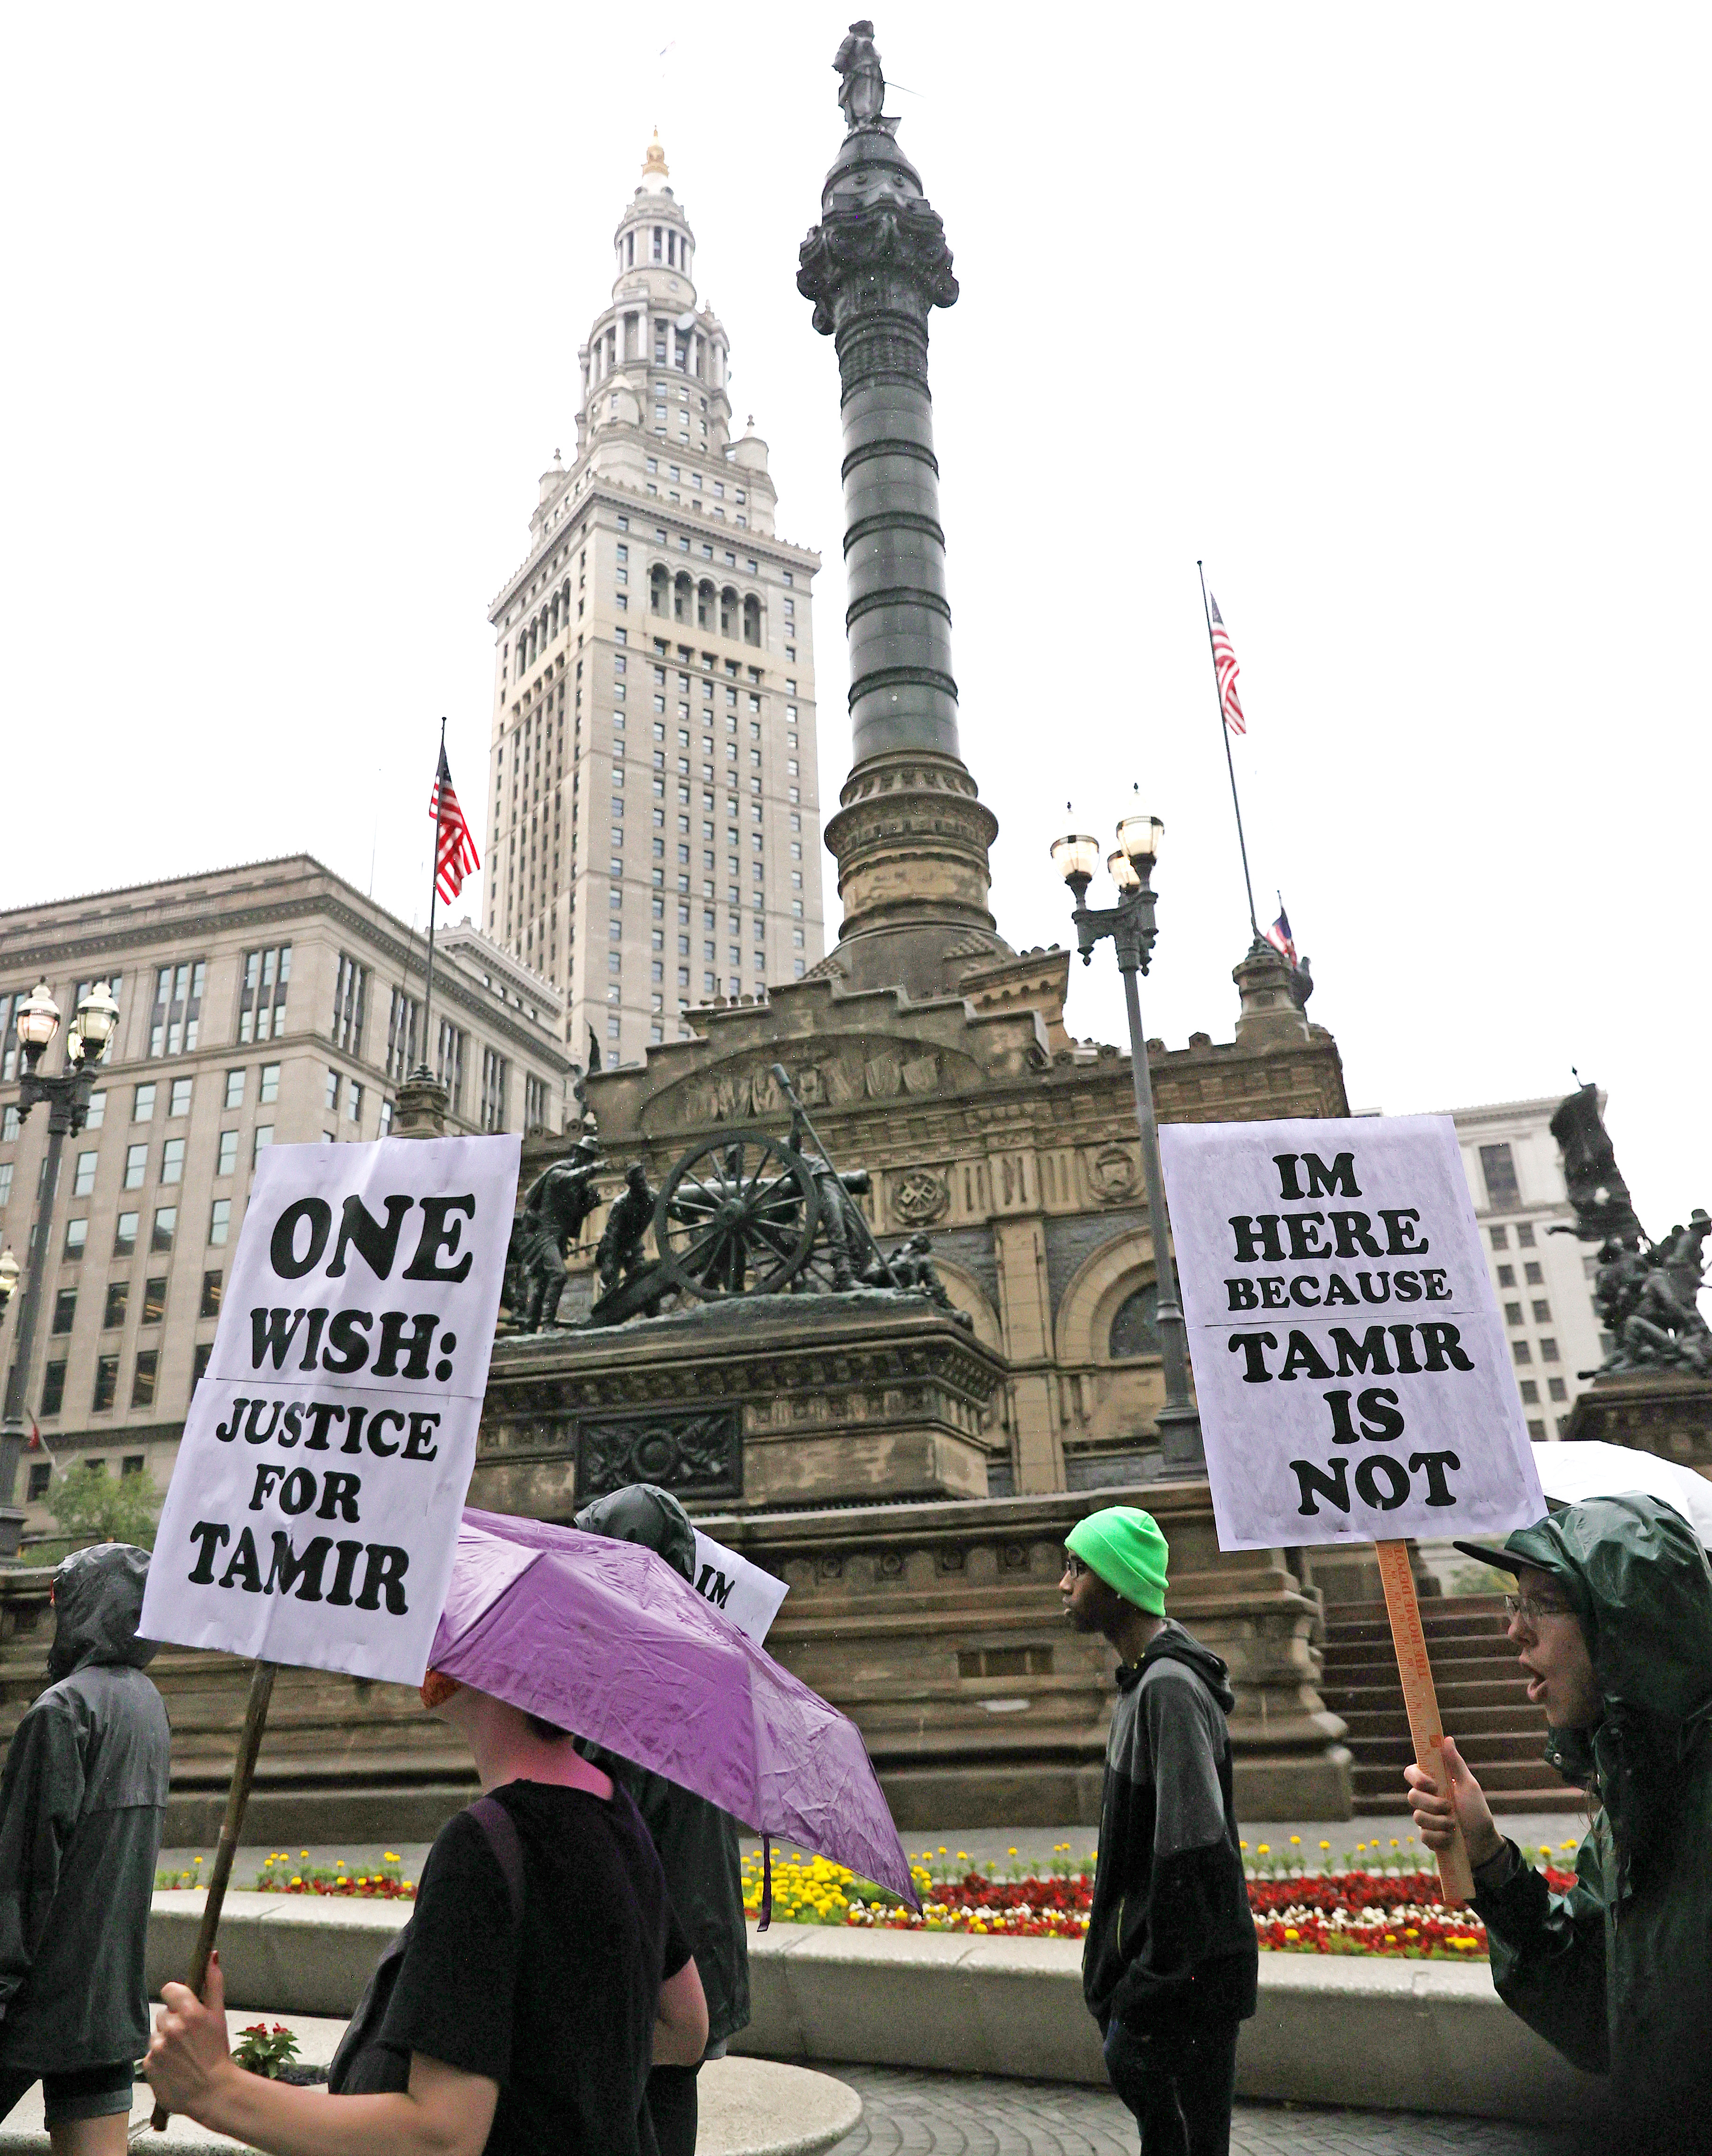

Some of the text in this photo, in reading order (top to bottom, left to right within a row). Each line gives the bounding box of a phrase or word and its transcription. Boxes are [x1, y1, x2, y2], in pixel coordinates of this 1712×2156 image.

[1273, 1153, 1362, 1200] IM
[271, 1194, 475, 1283] ONE
[1229, 1209, 1429, 1262] HERE
[1224, 1269, 1452, 1311] BECAUSE
[251, 1308, 456, 1381] WISH:
[1228, 1323, 1475, 1383] TAMIR
[216, 1399, 440, 1461] JUSTICE
[1323, 1388, 1404, 1444] IS
[249, 1464, 360, 1523] FOR
[1290, 1451, 1460, 1515] NOT
[188, 1521, 409, 1615] TAMIR
[695, 1564, 735, 1609] IM
[1394, 1547, 1427, 1679] THE HOME DEPOT
